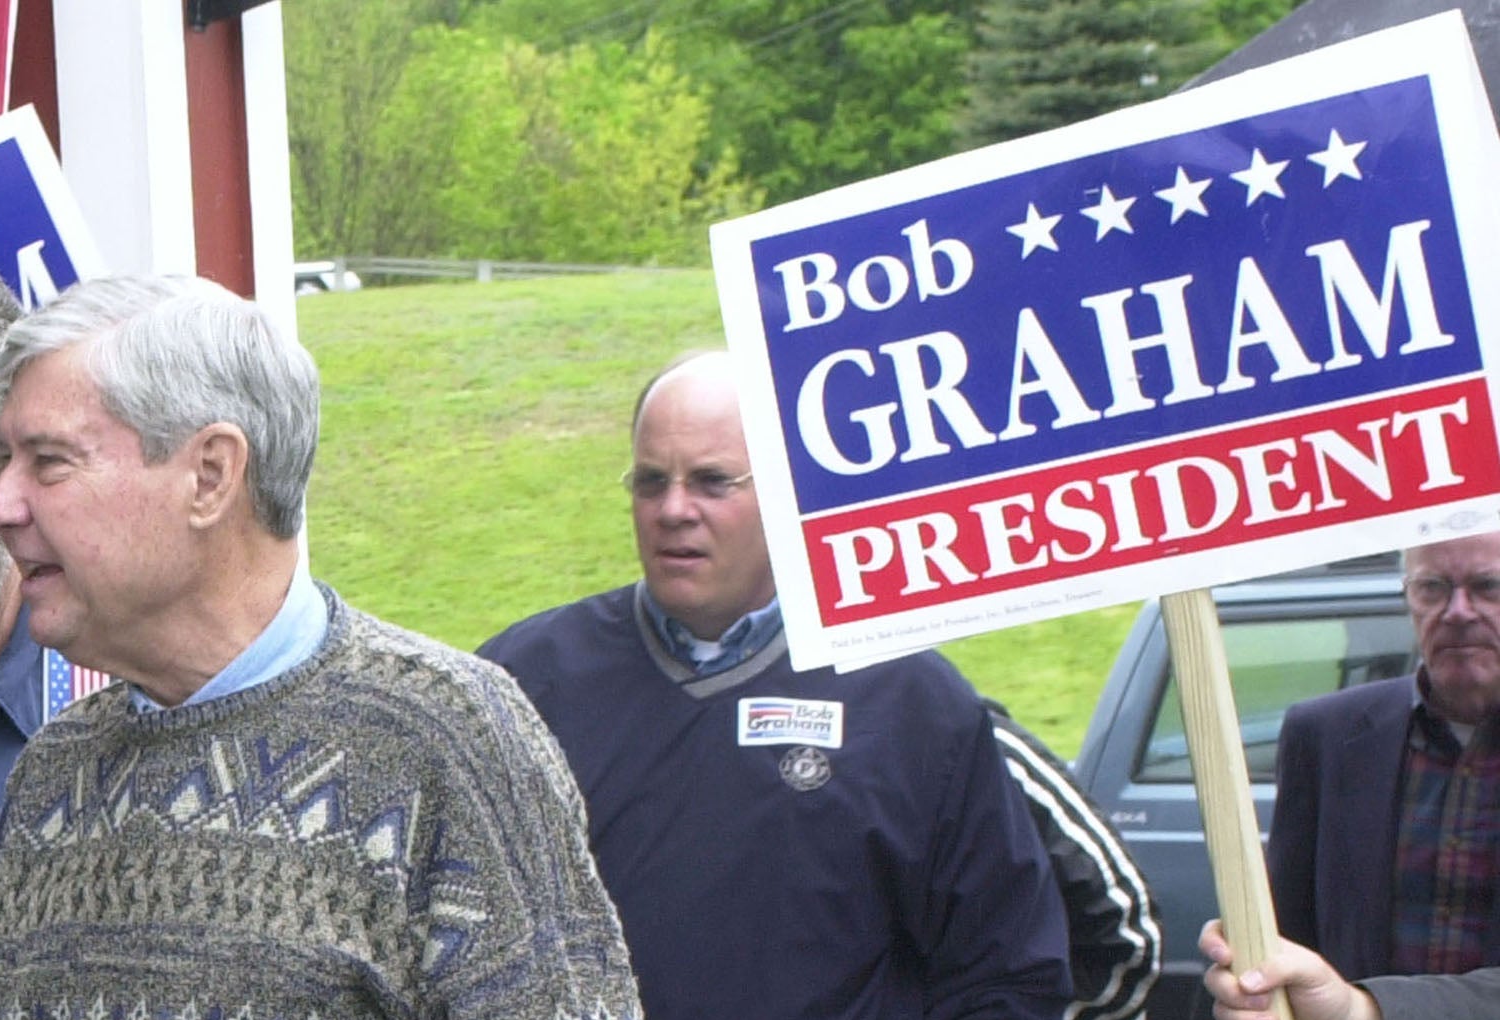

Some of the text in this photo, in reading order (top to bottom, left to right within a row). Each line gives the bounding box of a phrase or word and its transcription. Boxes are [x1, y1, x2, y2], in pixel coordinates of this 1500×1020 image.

[774, 219, 974, 332] Bob
[797, 219, 1455, 476] GRAHAM
[821, 396, 1469, 610] PRESIDENT
[748, 715, 831, 732] Graham
[797, 704, 834, 720] Bob
